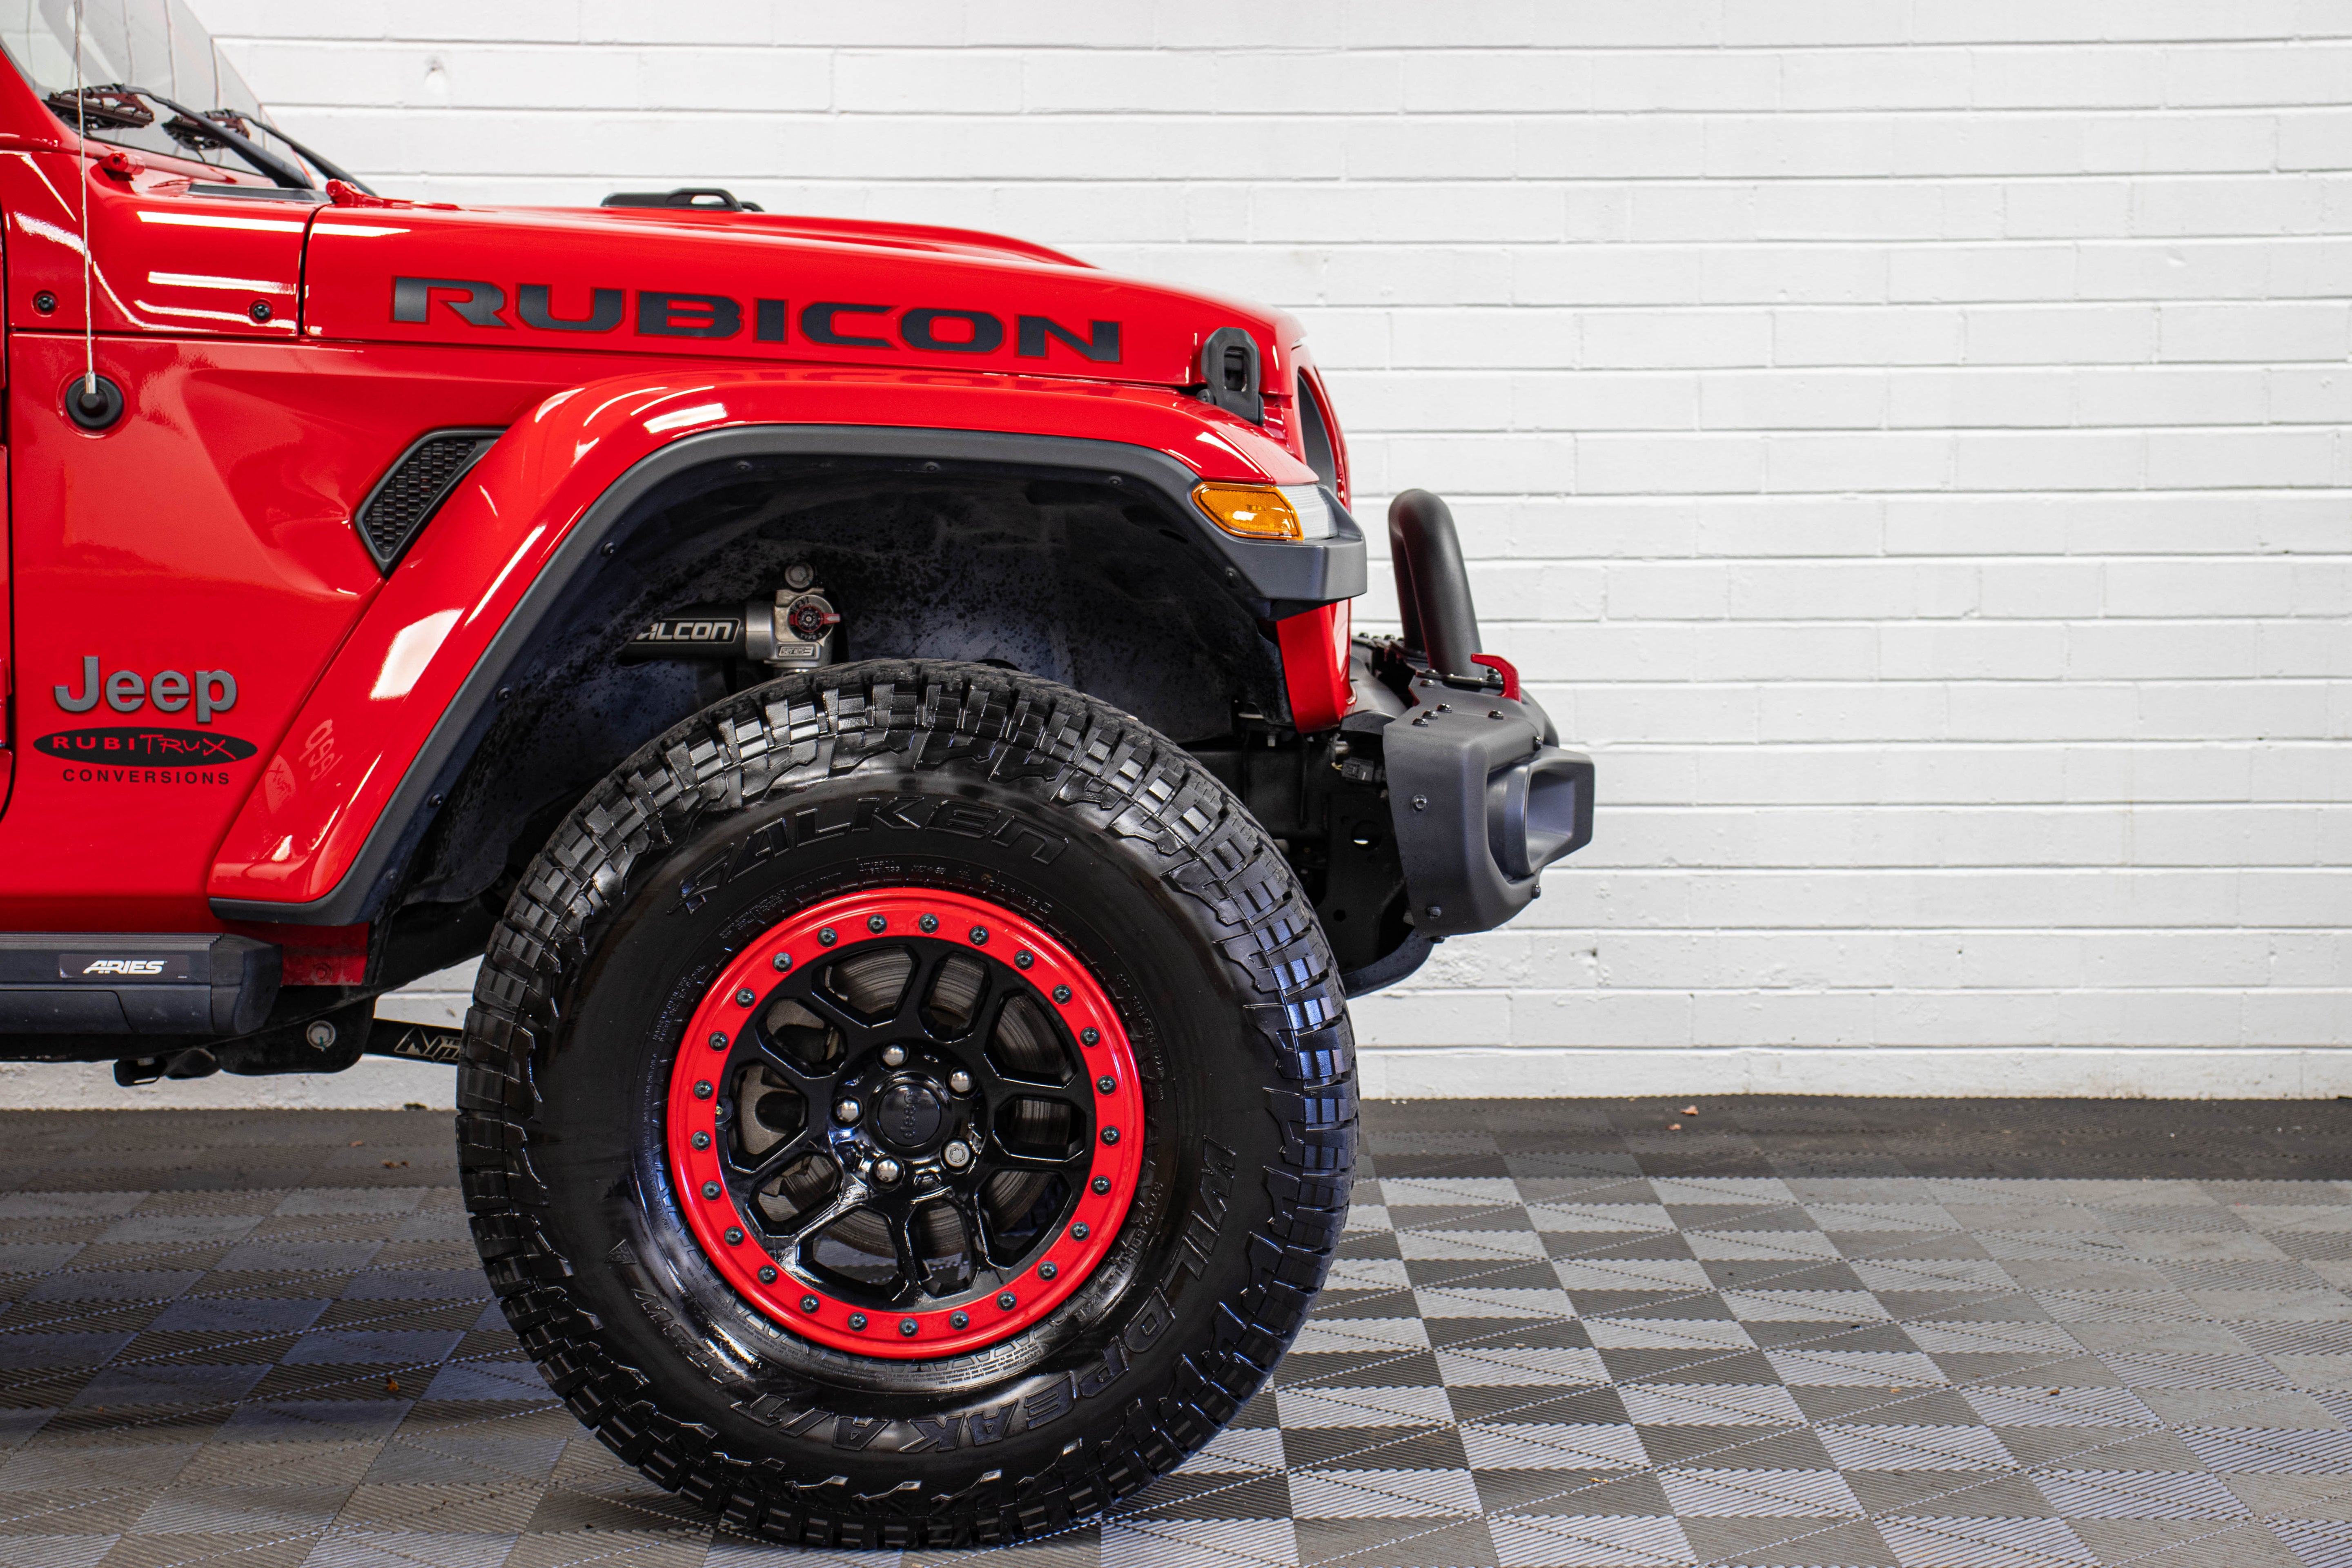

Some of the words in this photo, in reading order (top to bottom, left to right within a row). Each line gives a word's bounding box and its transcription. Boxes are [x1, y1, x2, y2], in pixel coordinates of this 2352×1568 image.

[391, 276, 1123, 363] RUBICON
[636, 621, 733, 641] ALCON
[54, 655, 238, 723] Jeep
[63, 769, 230, 785] CONVERSIONS
[668, 796, 1069, 913] FALKEN
[83, 960, 165, 975] ARIES
[900, 1091, 919, 1139] Jeep
[898, 1135, 1236, 1454] WILDPEAK
